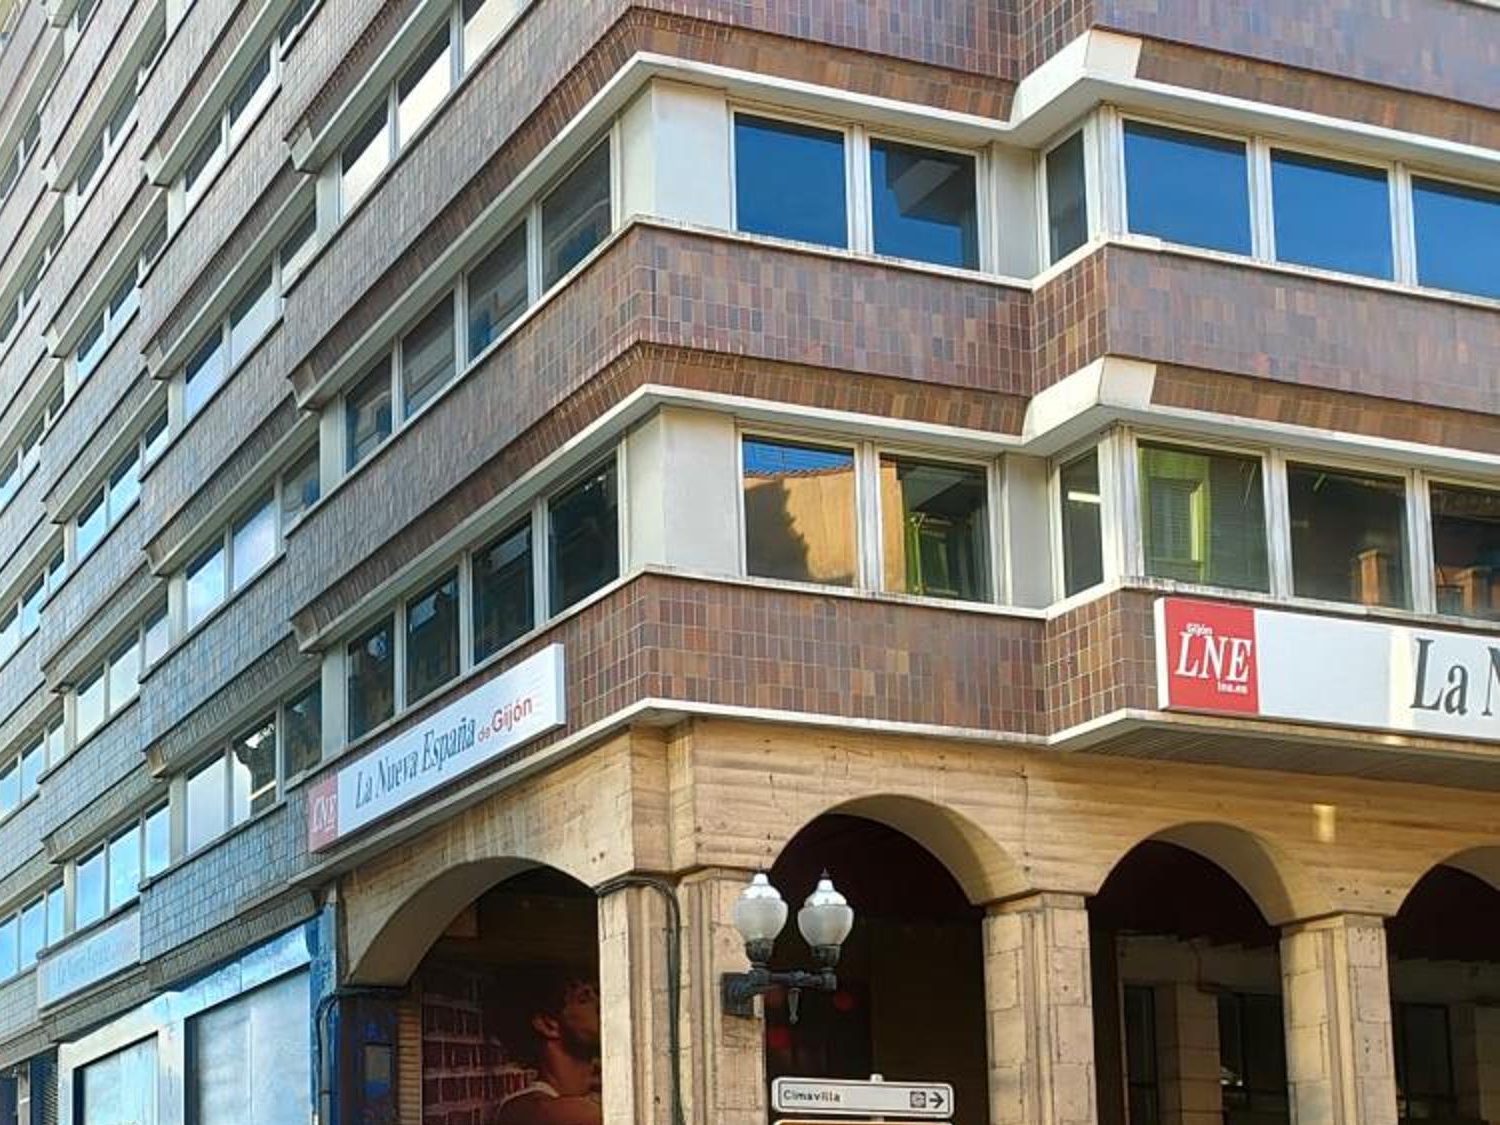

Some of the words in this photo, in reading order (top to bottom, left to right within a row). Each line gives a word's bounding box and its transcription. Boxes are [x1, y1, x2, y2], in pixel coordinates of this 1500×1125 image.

[1175, 631, 1252, 683] LNE
[1409, 637, 1469, 716] La
[356, 771, 373, 809] La
[375, 751, 418, 799] Nueva
[422, 717, 476, 772] España
[478, 728, 491, 743] de
[491, 697, 532, 732] Gijón
[783, 1089, 841, 1103] Cimavilla
